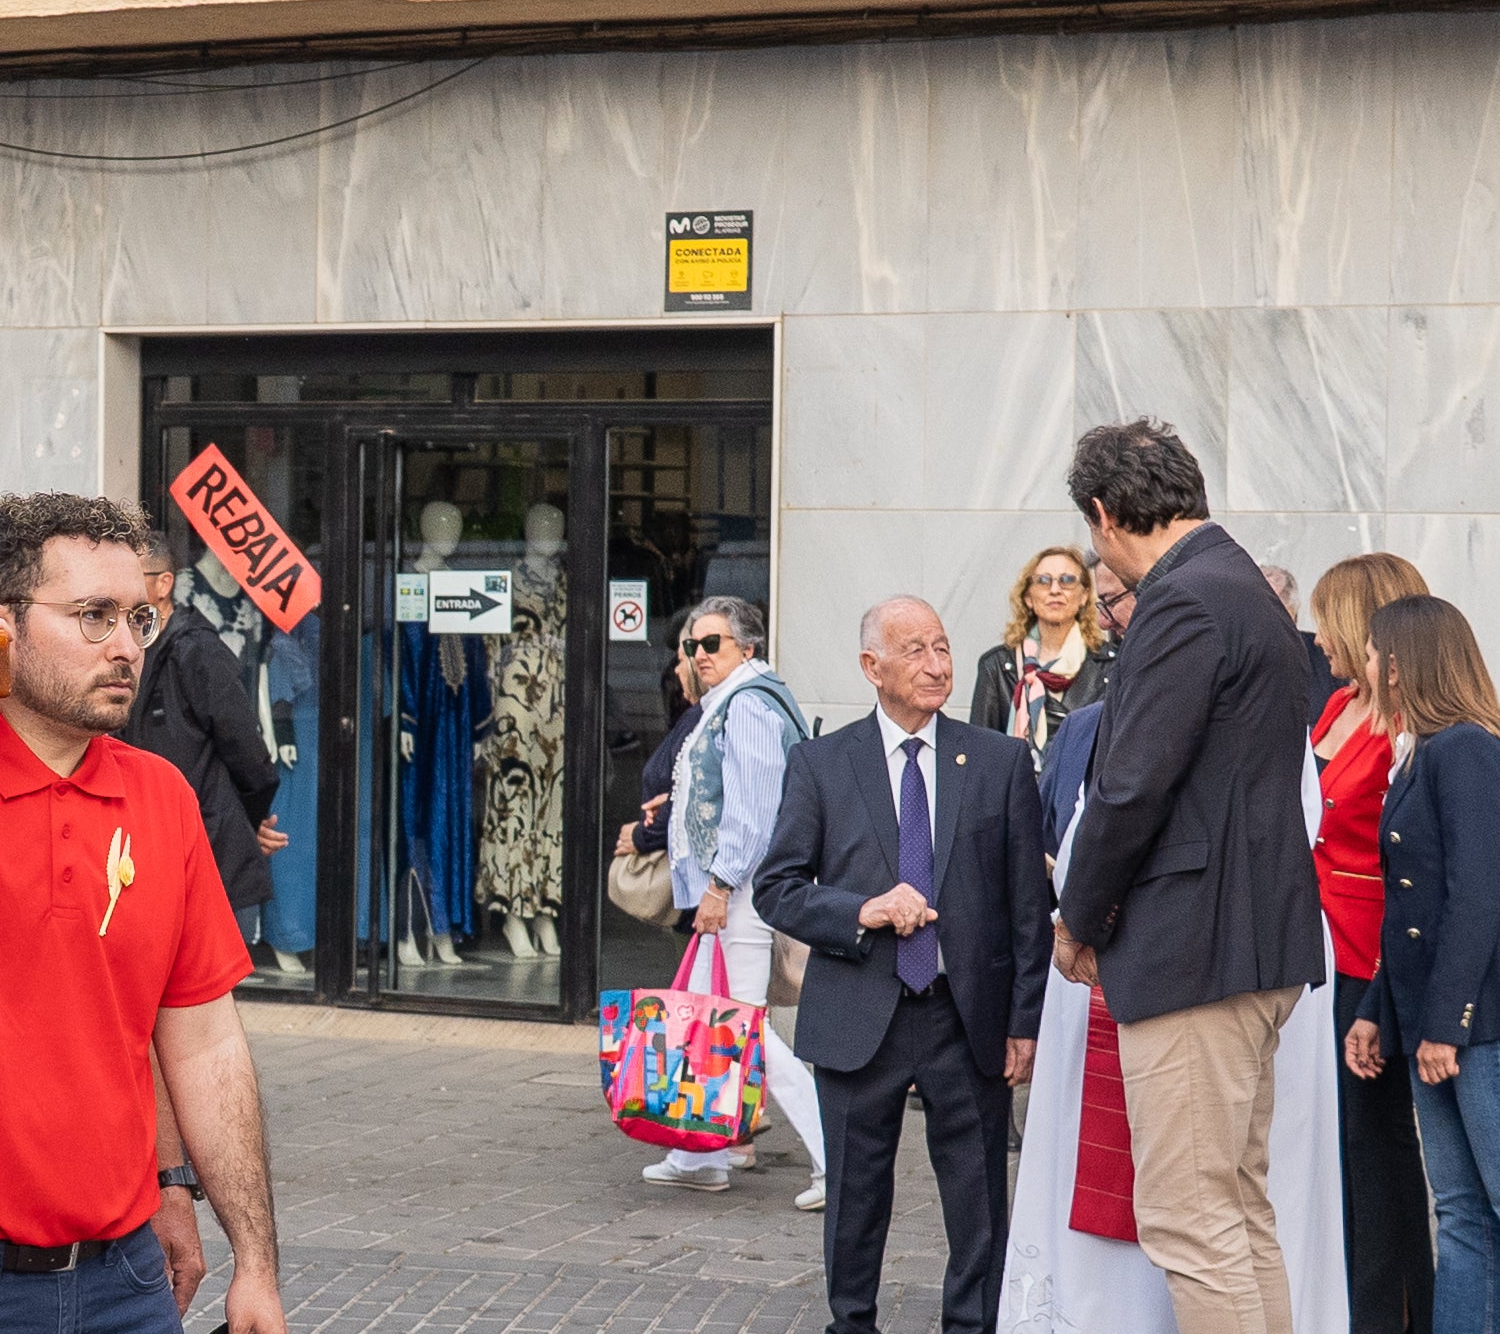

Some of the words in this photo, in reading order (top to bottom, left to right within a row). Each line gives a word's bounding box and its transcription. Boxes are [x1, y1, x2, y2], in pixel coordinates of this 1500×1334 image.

[675, 248, 742, 257] CONECTADA
[186, 463, 304, 614] REBAJA
[436, 599, 482, 610] ENTRADA
